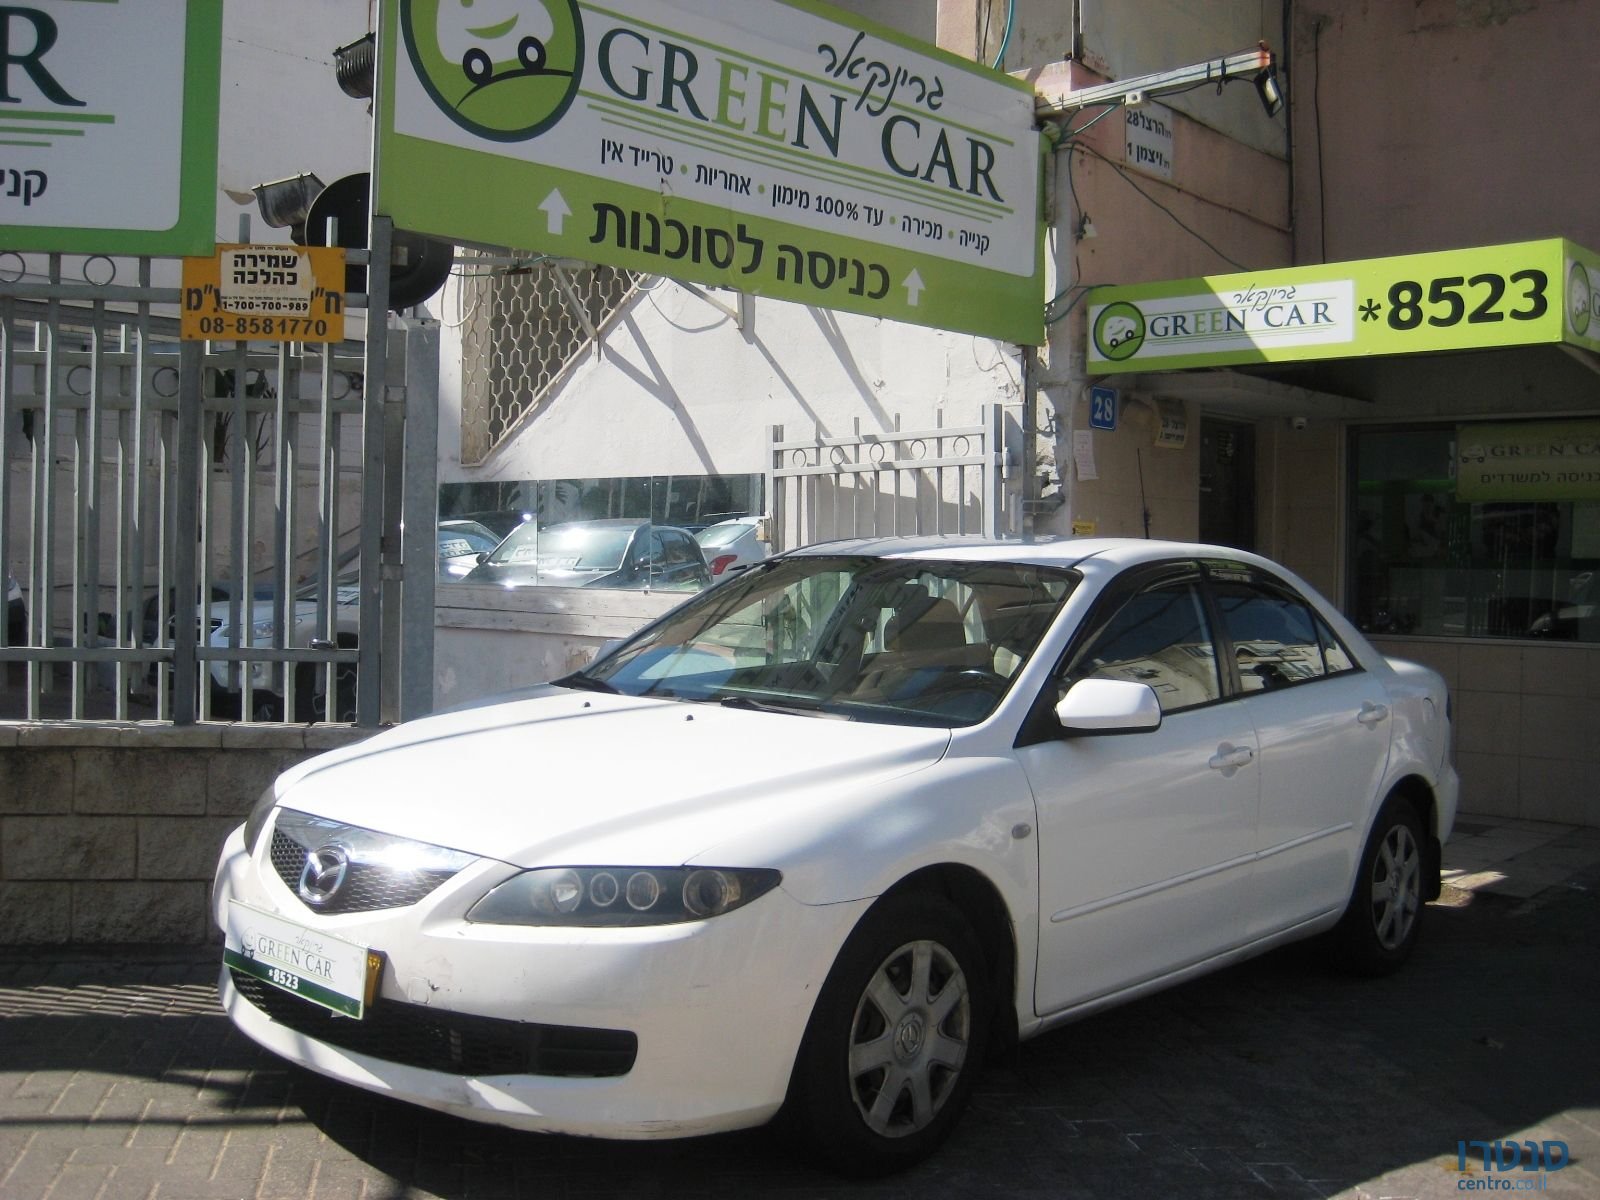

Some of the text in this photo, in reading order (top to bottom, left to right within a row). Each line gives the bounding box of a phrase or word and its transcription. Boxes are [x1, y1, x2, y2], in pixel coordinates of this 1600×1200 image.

[598, 27, 1004, 202] GREEN CAR
[1127, 142, 1132, 156] 1
[601, 139, 990, 256] קנייה מכירה עד 100% מימון אחריות טרייד אין
[233, 254, 298, 269] שמירה
[589, 202, 890, 300] כניסה לסוכנות
[233, 269, 298, 286] כהלכה
[223, 300, 309, 311] 1-700-700-989
[200, 317, 327, 336] 08-8581770
[1149, 301, 1333, 338] GREEN CAR
[1093, 395, 1113, 421] 28
[258, 936, 333, 979] GREEN CAR
